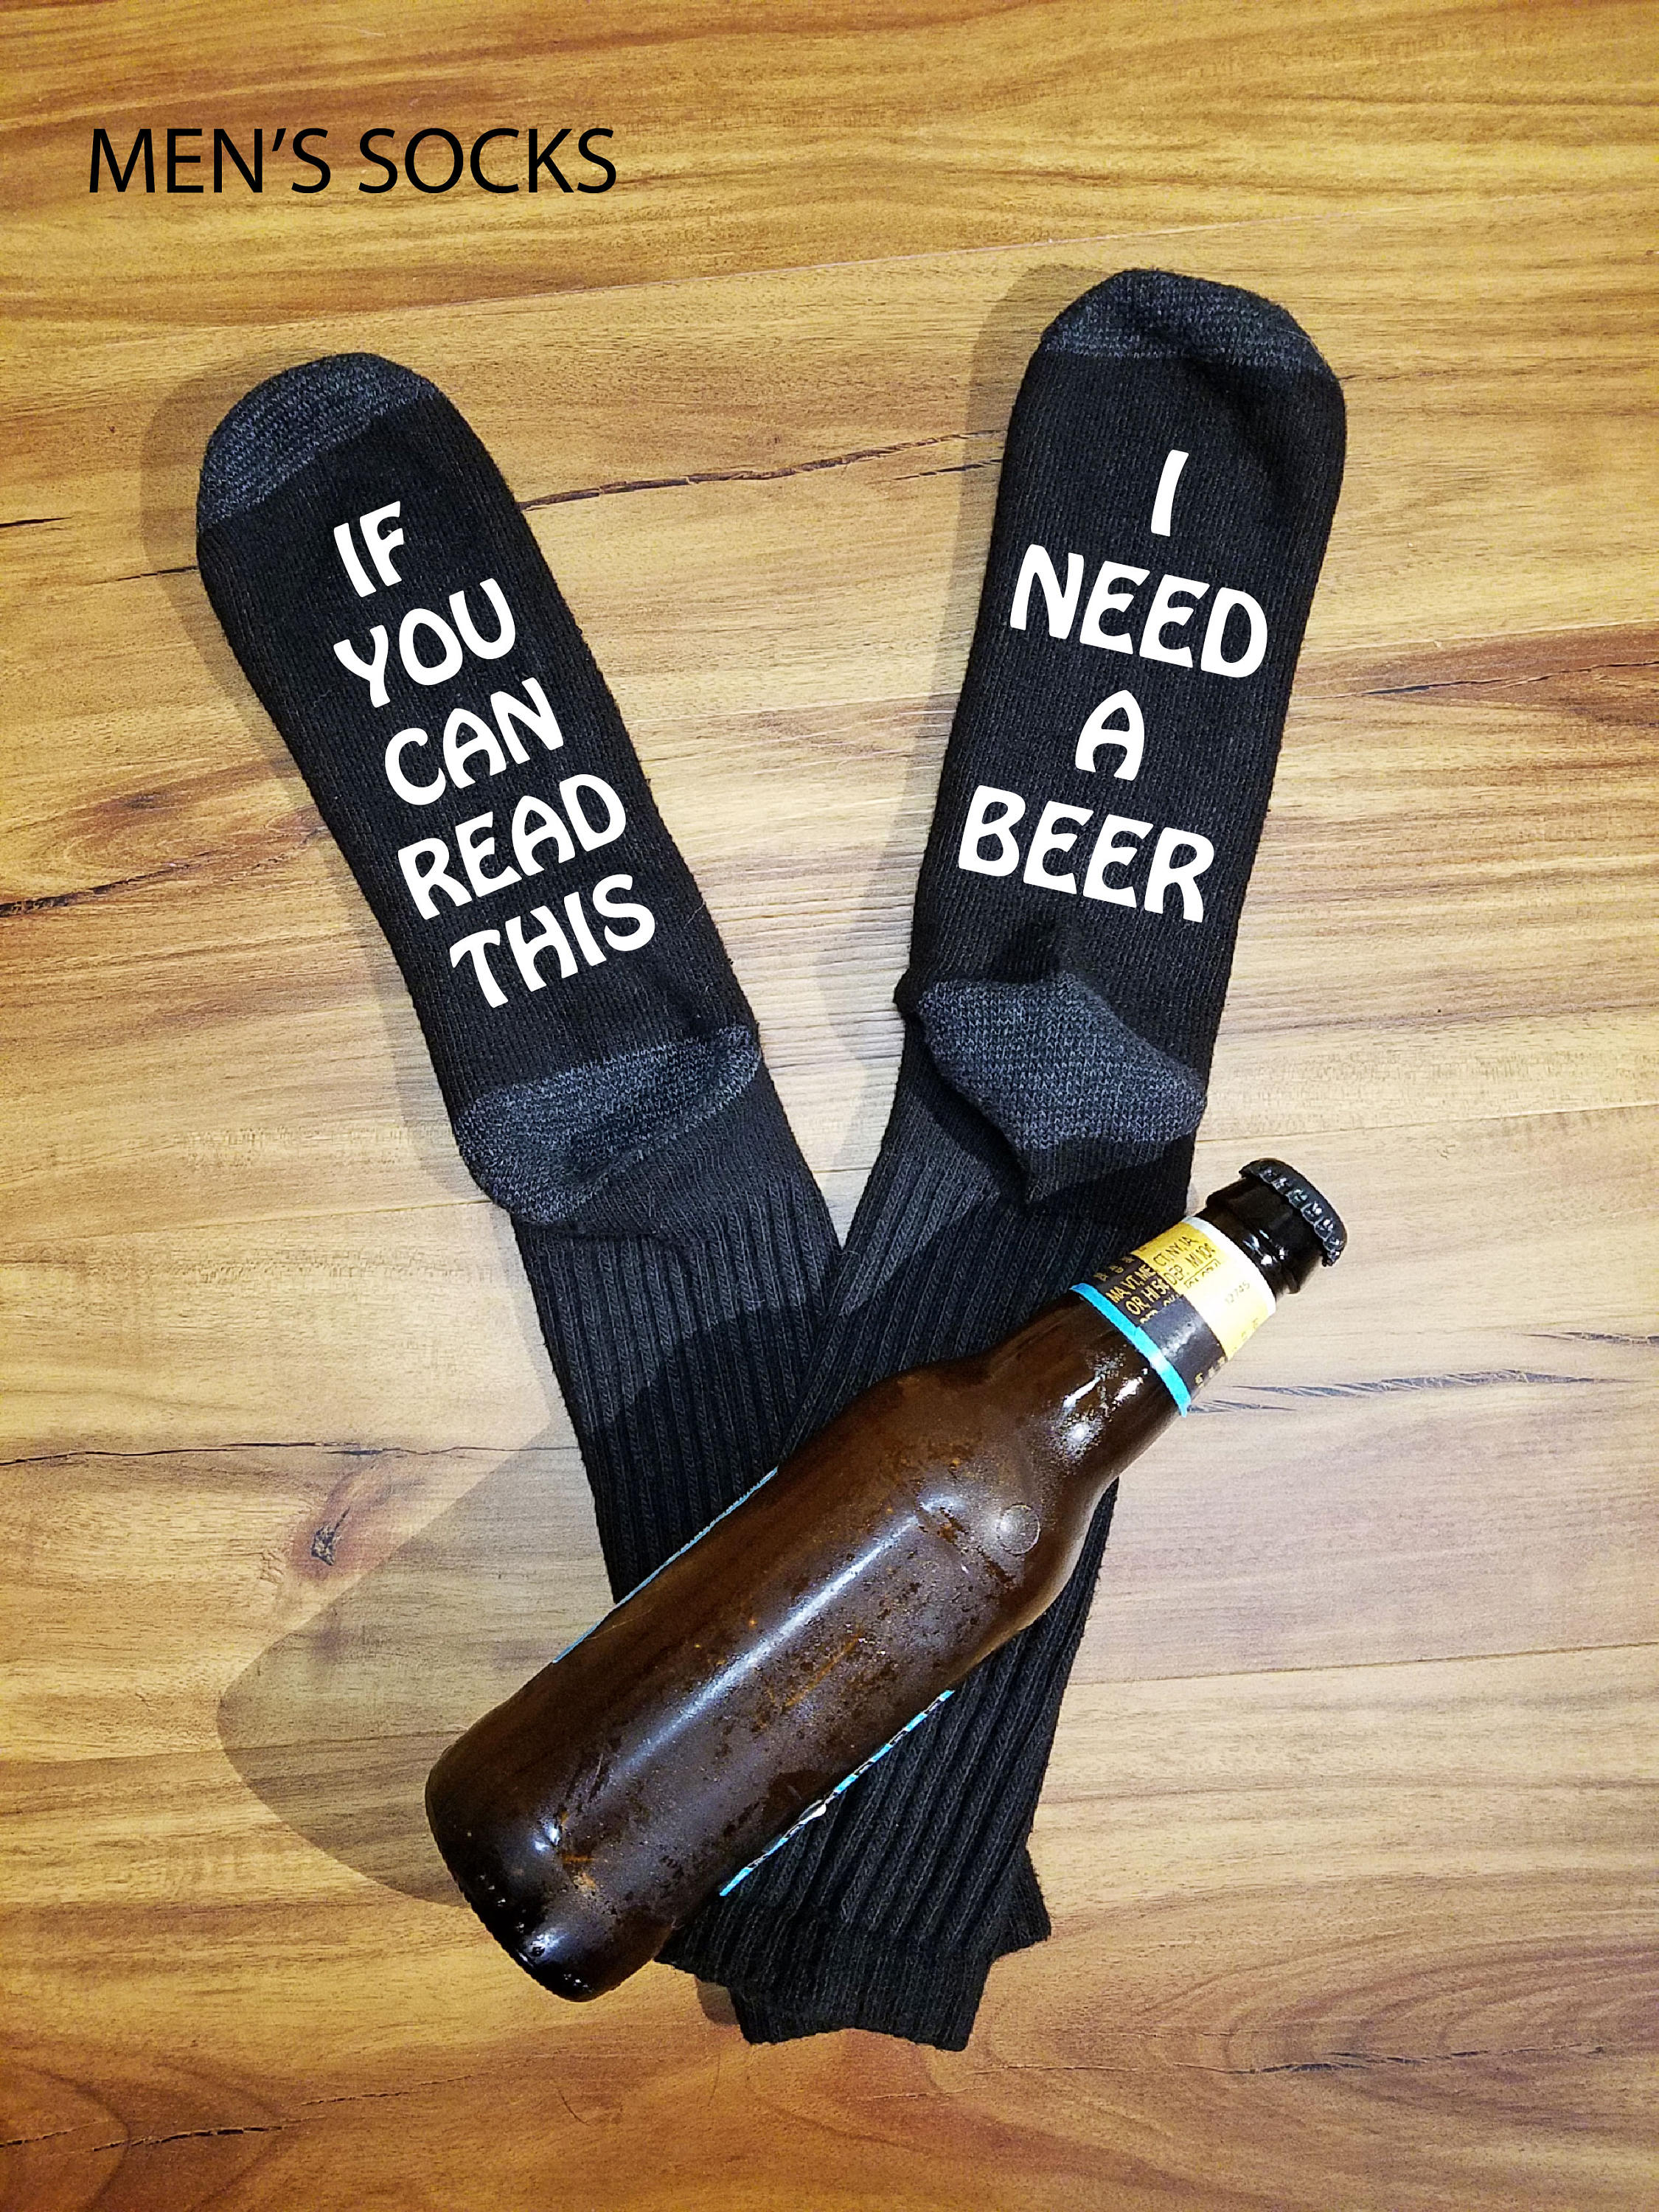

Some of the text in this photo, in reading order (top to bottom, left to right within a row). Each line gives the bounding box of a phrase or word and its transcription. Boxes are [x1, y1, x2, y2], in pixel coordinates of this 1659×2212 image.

[333, 501, 405, 598] IF
[1150, 449, 1189, 538] I
[333, 577, 516, 709] YOU
[1009, 543, 1268, 678] NEED
[384, 677, 564, 806] CAN
[1075, 689, 1145, 781] A
[397, 773, 627, 921] READ
[958, 785, 1215, 923] BEER
[449, 874, 655, 1009] THIS
